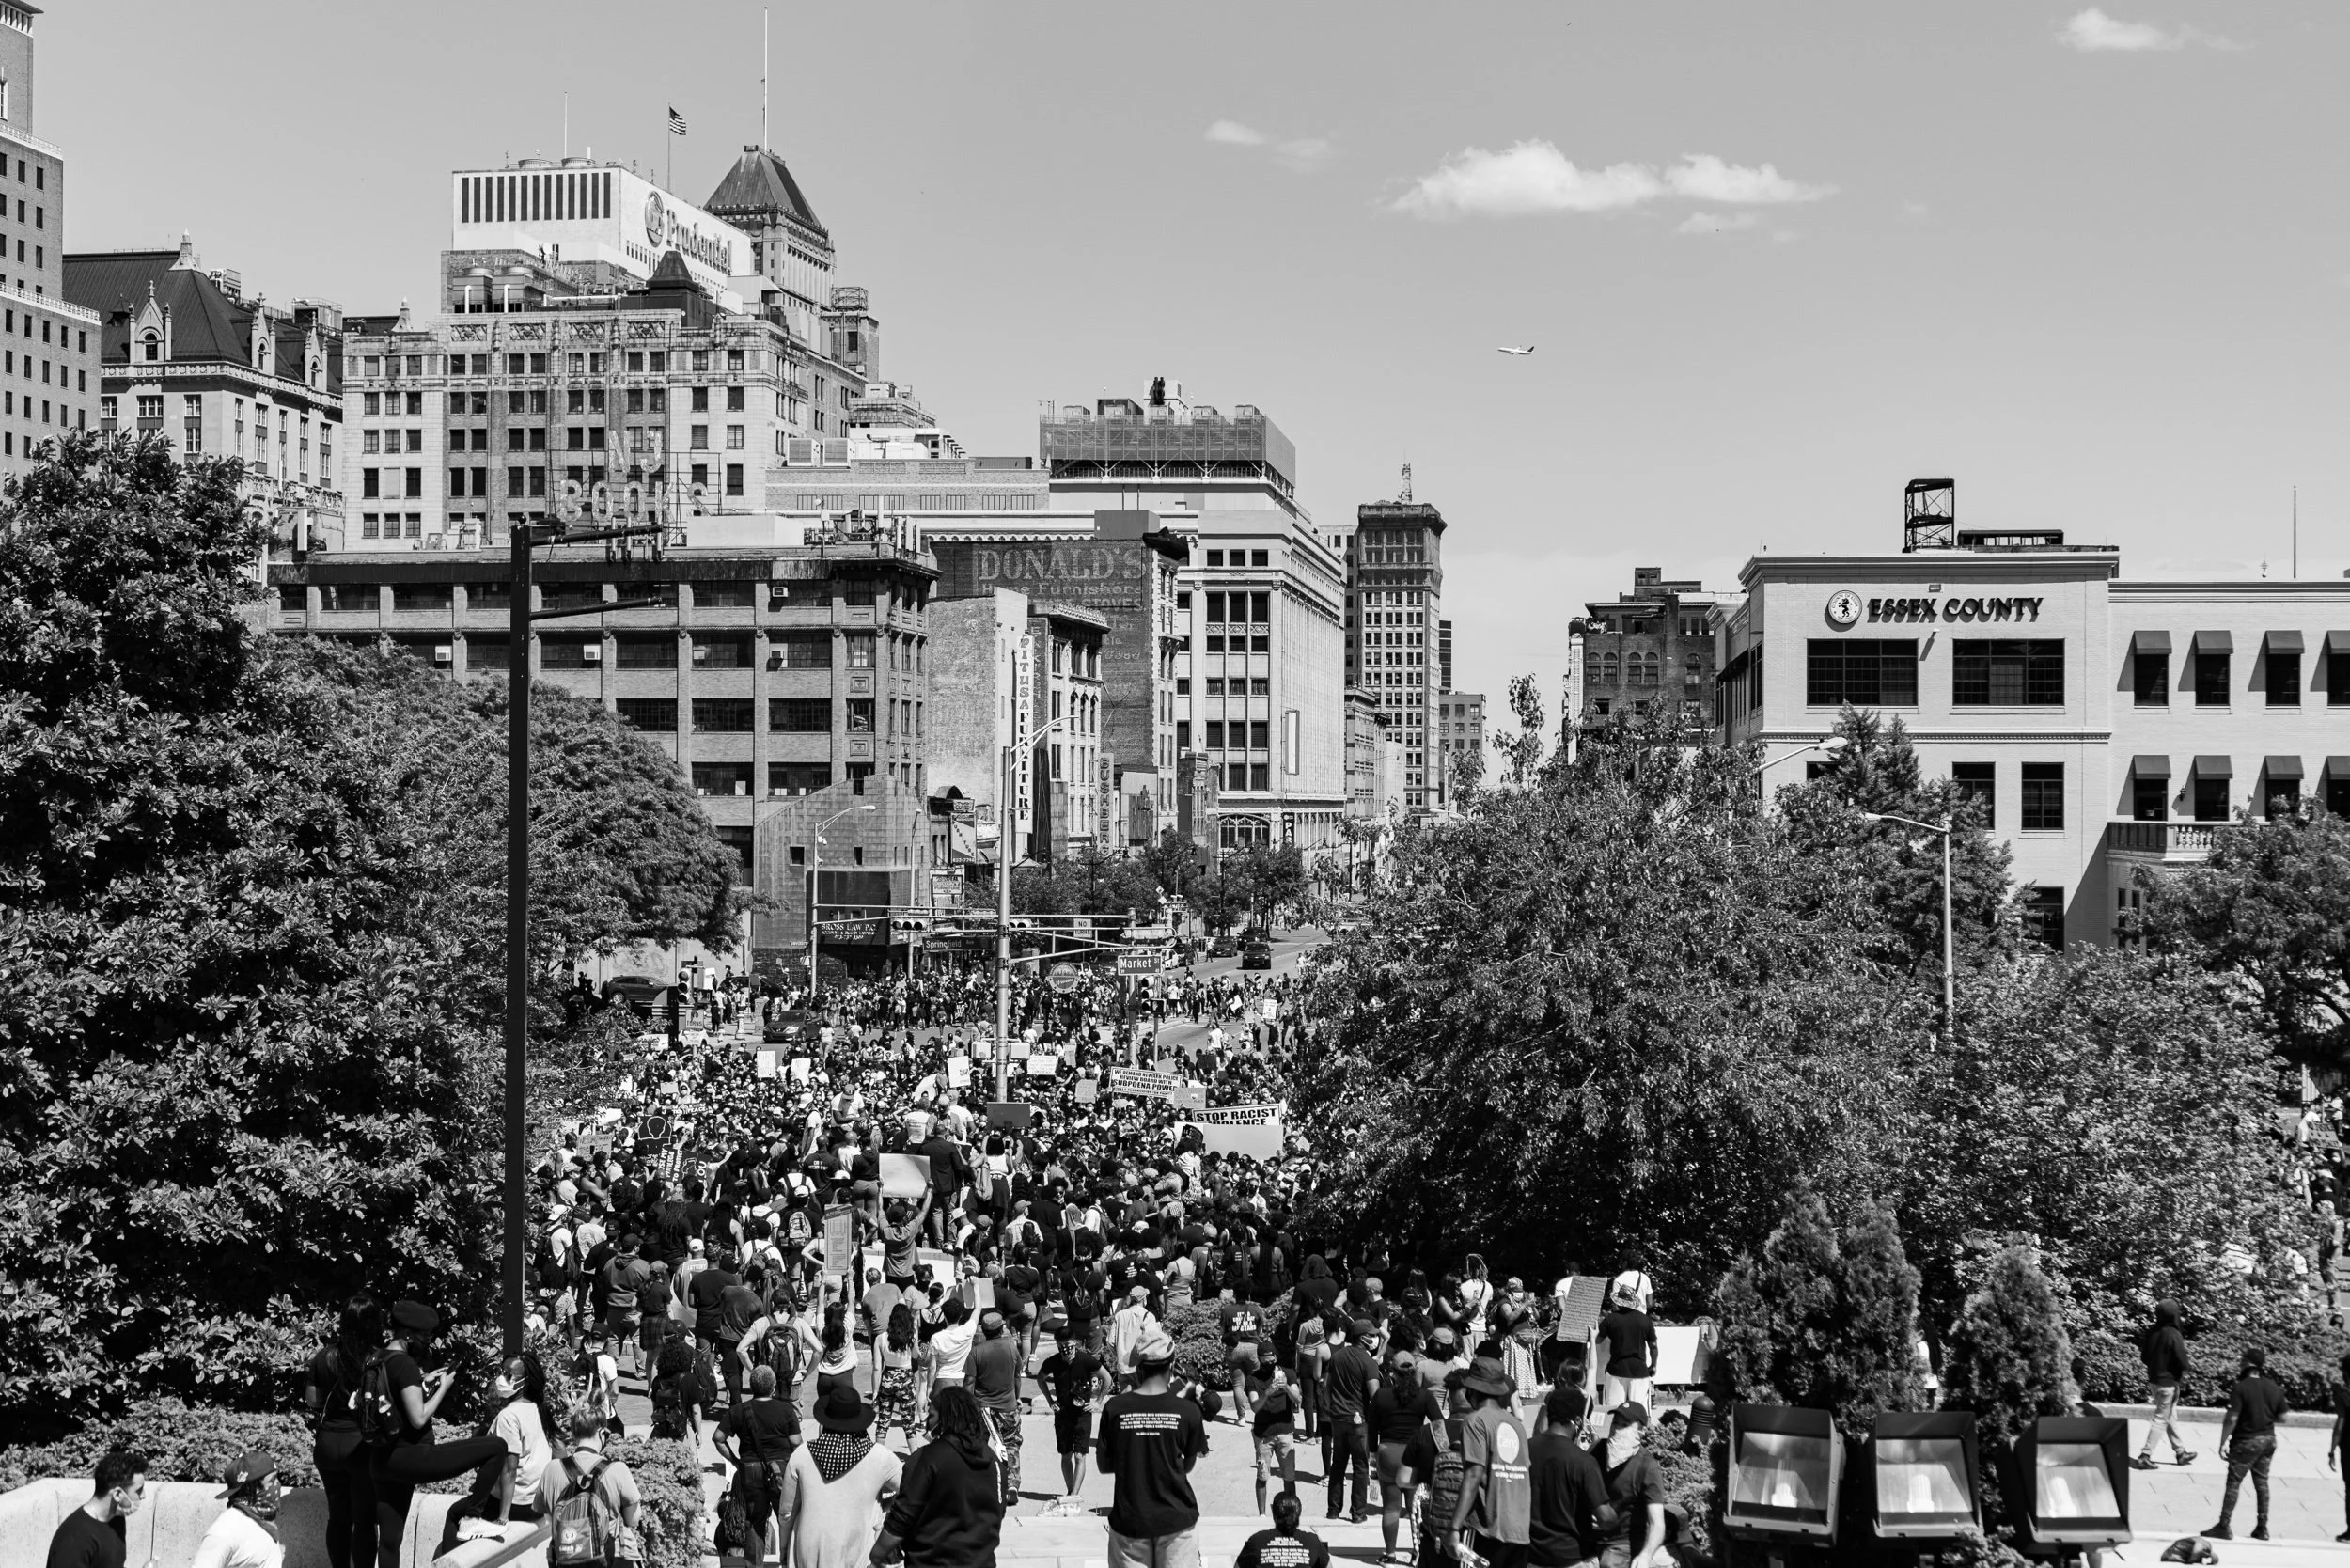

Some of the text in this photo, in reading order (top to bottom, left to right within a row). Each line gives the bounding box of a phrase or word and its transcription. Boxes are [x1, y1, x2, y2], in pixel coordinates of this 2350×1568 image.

[666, 209, 731, 275] Prudential
[609, 431, 663, 473] NJ
[558, 479, 708, 523] BOOKS
[979, 548, 1147, 580] DONALD'S
[1869, 598, 2044, 617] ESSEX COUNTY
[1020, 637, 1030, 710] PITUSA
[1074, 929, 1090, 937] TURNS
[926, 939, 962, 949] Springfield
[1120, 958, 1151, 968] Market
[1114, 1079, 1150, 1090] SUBPOENA
[1197, 1108, 1277, 1121] STOP RACIST
